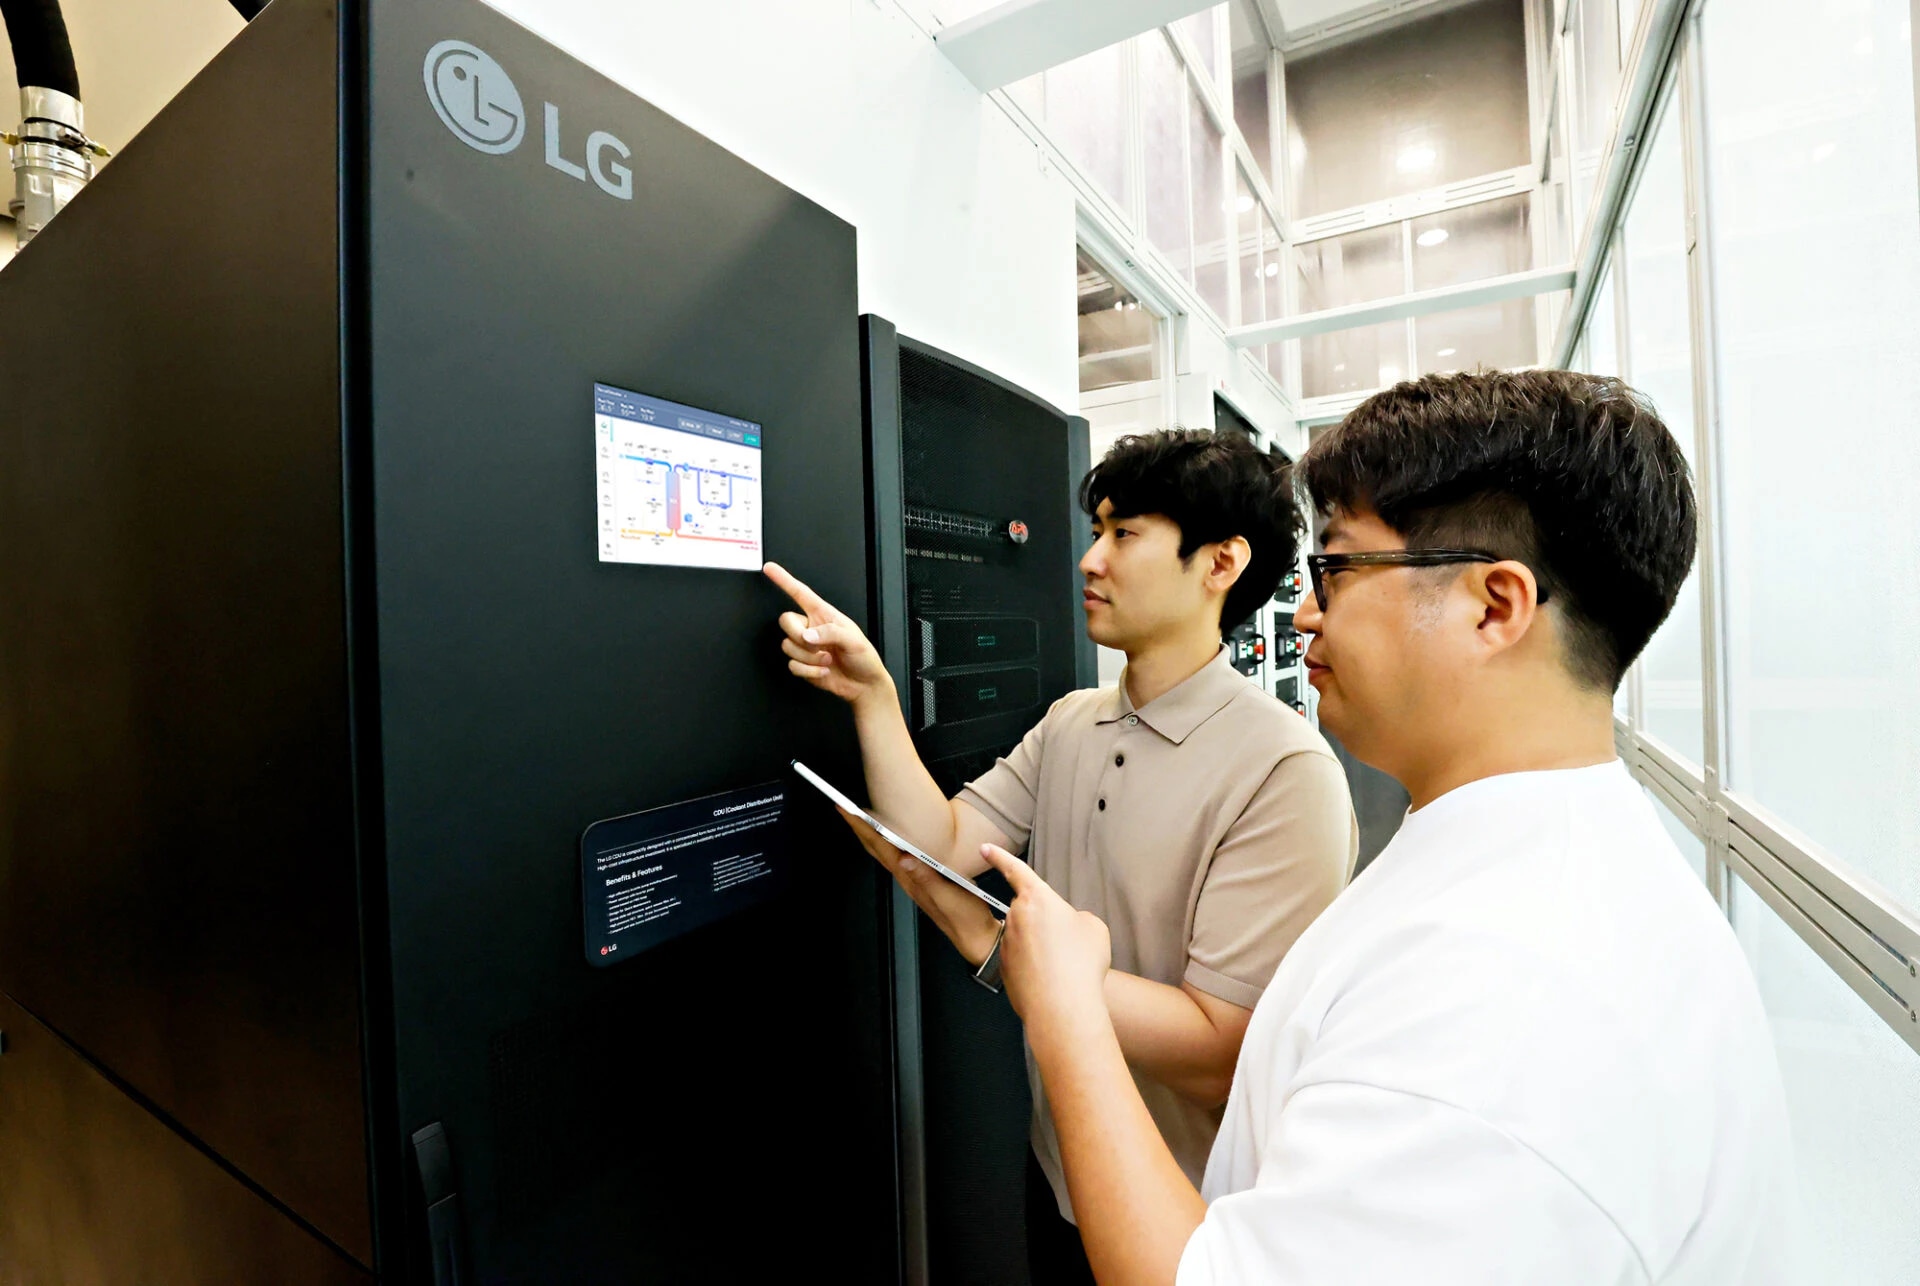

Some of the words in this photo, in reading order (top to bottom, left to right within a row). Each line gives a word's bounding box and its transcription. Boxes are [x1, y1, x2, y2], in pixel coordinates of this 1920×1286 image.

[544, 100, 633, 201] LG
[713, 808, 725, 817] CDU
[746, 796, 772, 809] Distribution
[605, 872, 631, 887] Benefits
[631, 870, 637, 880] &
[637, 865, 663, 879] Features
[609, 944, 617, 952] LG
